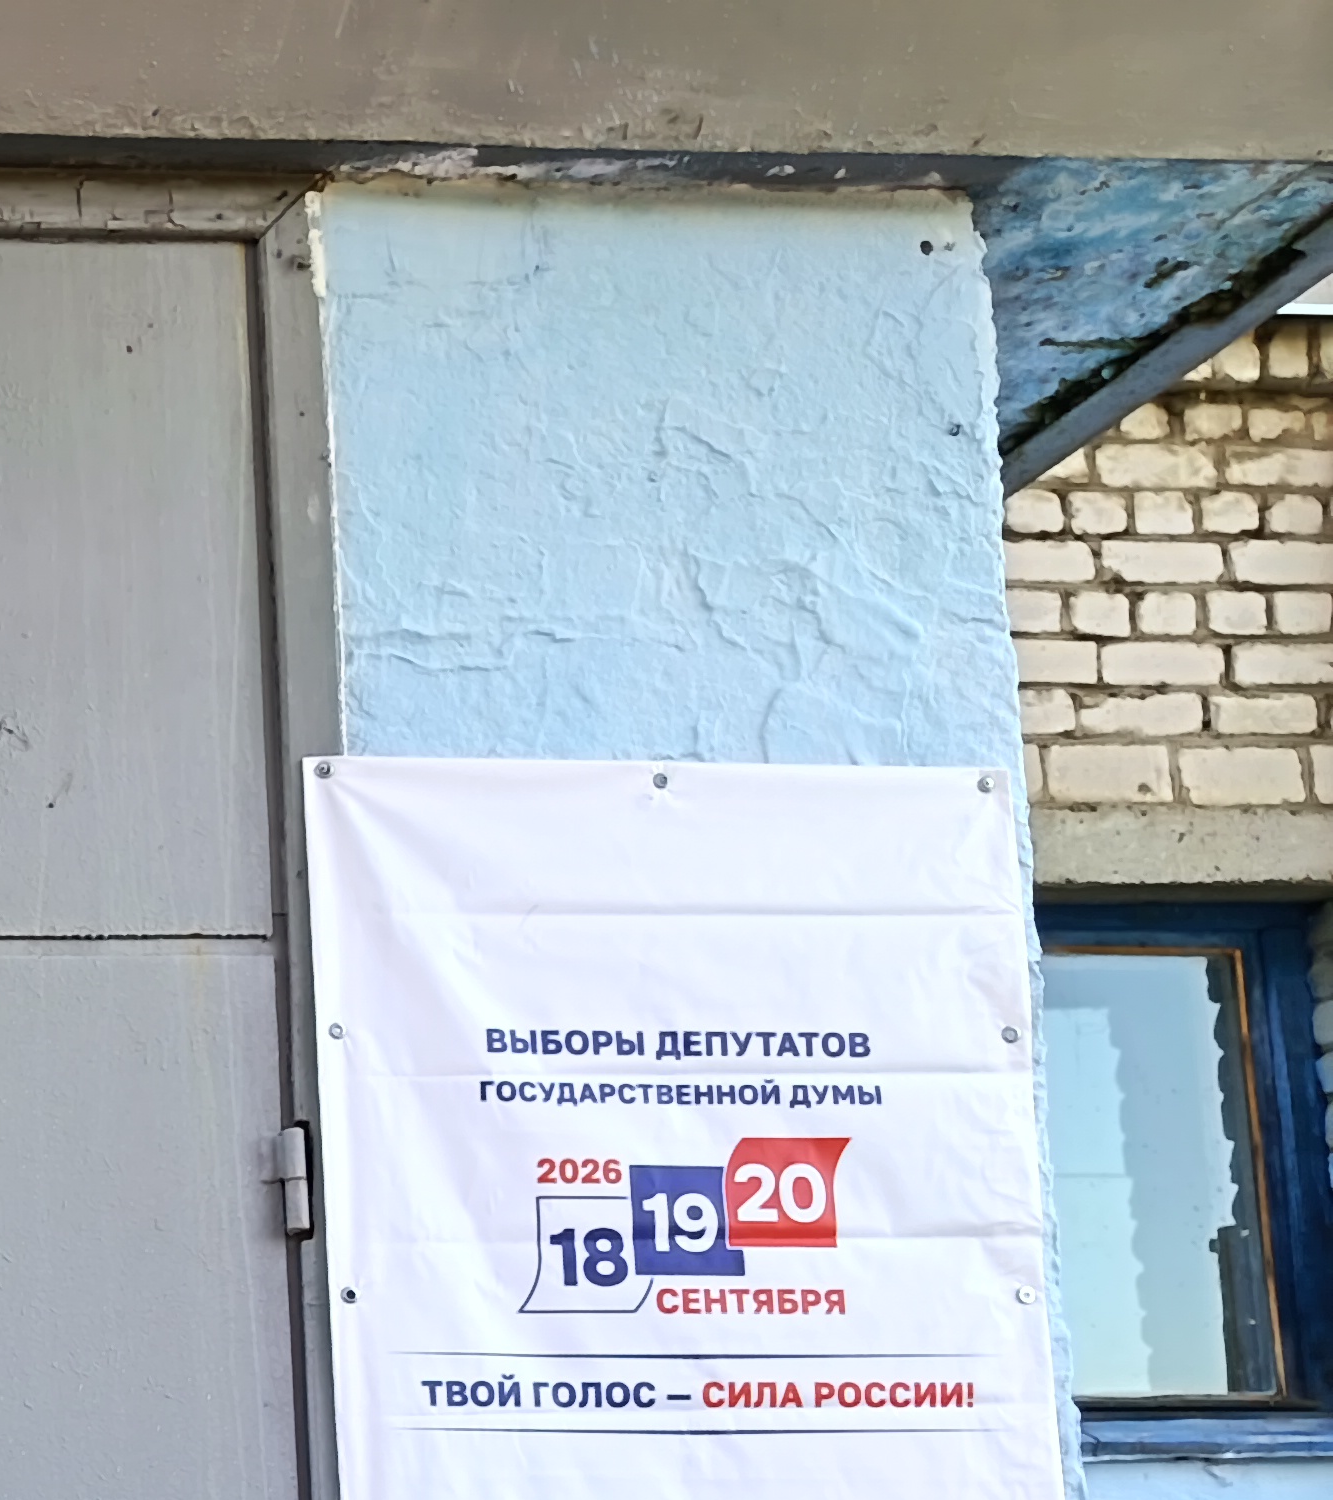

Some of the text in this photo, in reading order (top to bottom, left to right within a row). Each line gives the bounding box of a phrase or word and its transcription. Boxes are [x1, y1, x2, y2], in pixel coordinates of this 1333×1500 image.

[486, 1028, 871, 1061] ВЫБОРЫ ДЕПУТАТОВ
[479, 1079, 882, 1109] ГОСУДАРСТВЕННОЙ ДУМЫ
[537, 1158, 622, 1184] 2026
[549, 1162, 827, 1287] 18 19 20
[656, 1288, 846, 1315] СЕНТЯБРЯ
[421, 1374, 522, 1408] ТВОЙ
[532, 1381, 656, 1409] ГОЛОС
[702, 1381, 803, 1408] СИЛА
[814, 1382, 974, 1408] РОССИИ!
